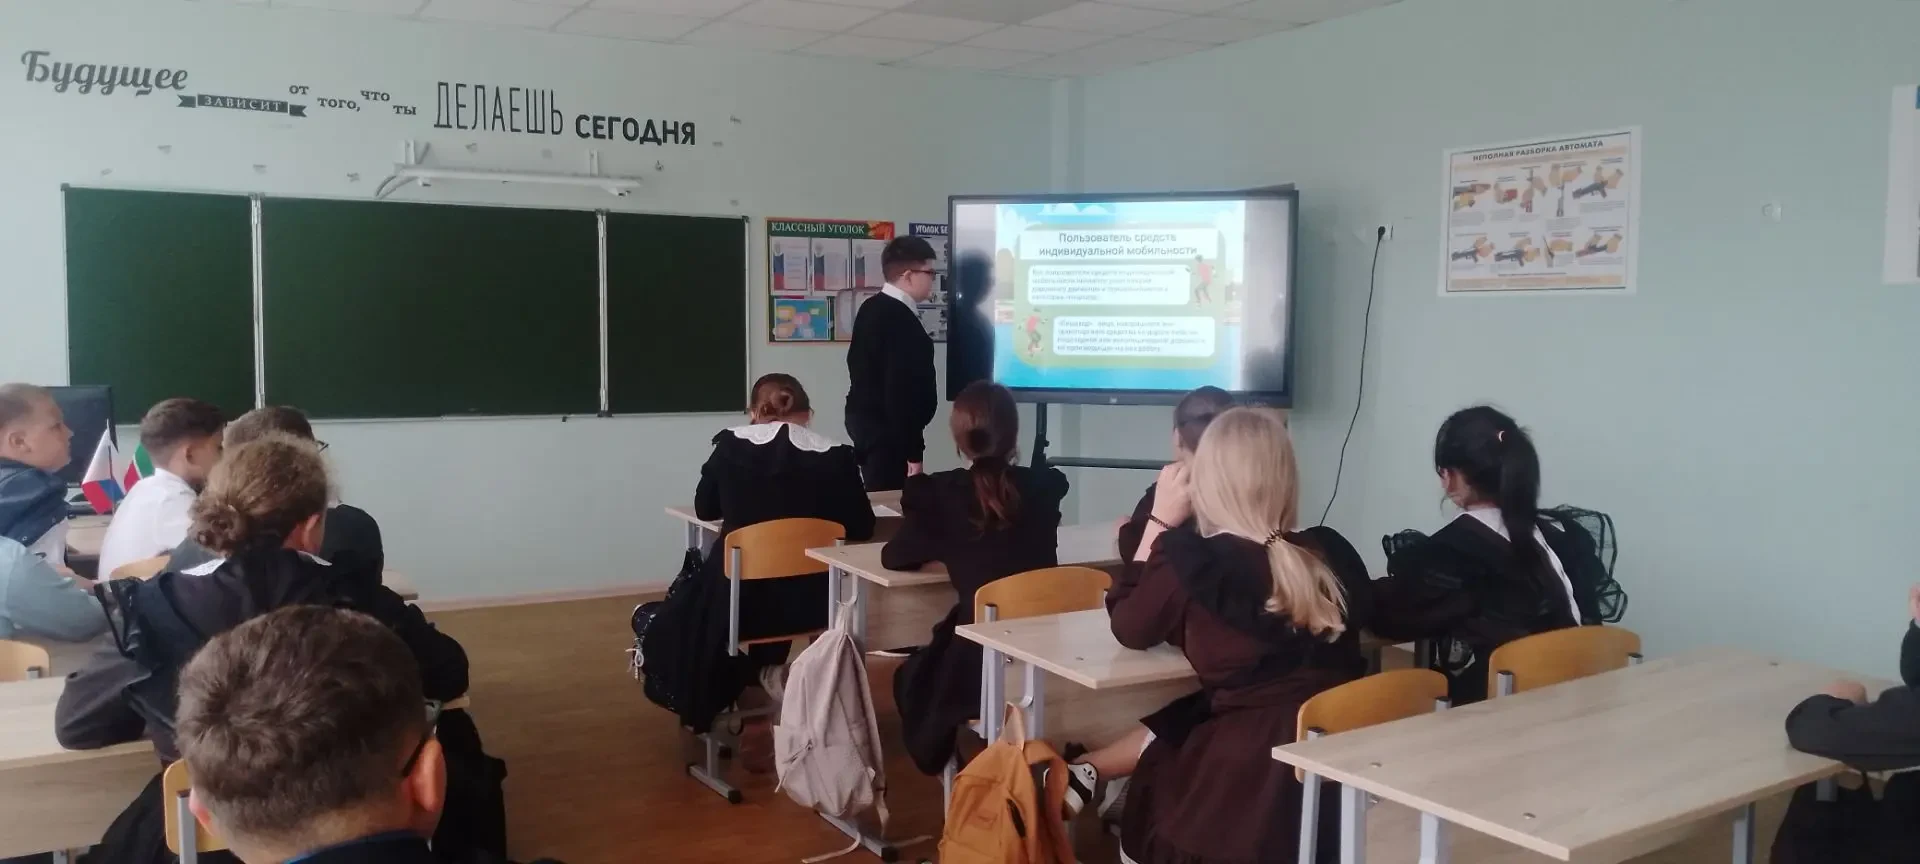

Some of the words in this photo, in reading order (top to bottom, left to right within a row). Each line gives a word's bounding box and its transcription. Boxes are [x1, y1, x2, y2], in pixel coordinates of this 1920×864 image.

[20, 51, 189, 96] Будущее
[203, 96, 283, 111] ЗАВИСИТ
[433, 81, 564, 135] ДЕЛАЕШЬ
[575, 114, 696, 146] СЕГОДНЯ
[1559, 140, 1604, 152] АВТОМАТА
[771, 222, 825, 233] КЛАССНЫЙ
[828, 224, 865, 235] УГОЛОК
[915, 224, 939, 235] УГОЛОК
[1059, 232, 1132, 243] Пользователь
[1039, 246, 1124, 257] индивидуальной
[1127, 246, 1198, 256] мобильности
